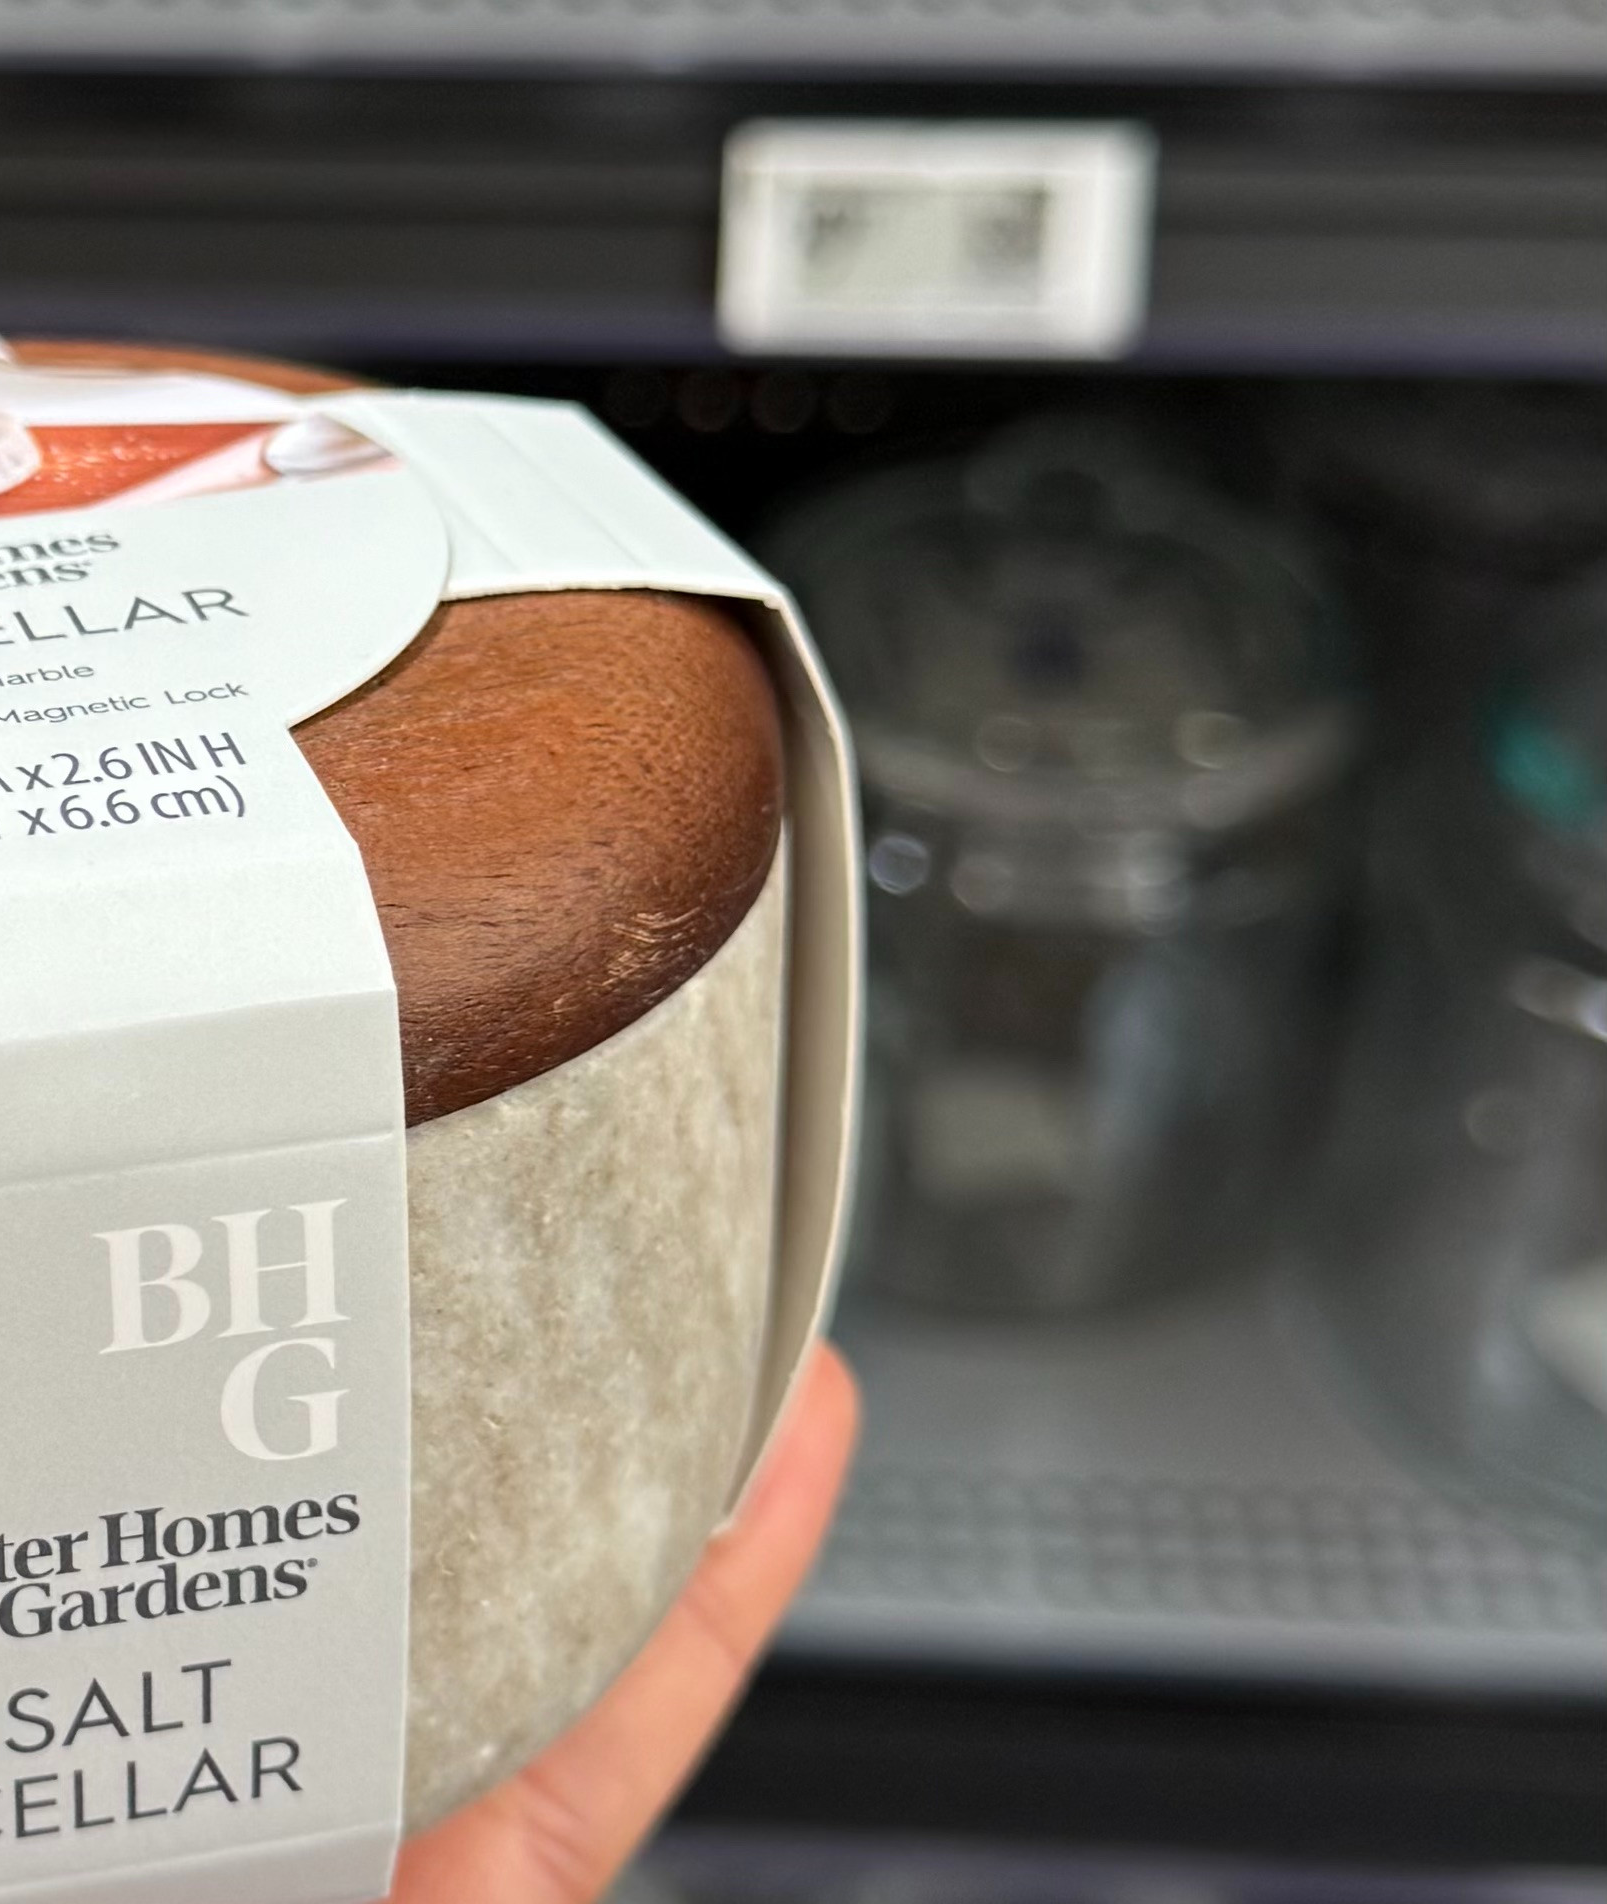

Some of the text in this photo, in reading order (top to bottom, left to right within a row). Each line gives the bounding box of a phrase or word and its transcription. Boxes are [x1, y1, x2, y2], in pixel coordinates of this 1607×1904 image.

[163, 682, 248, 705] Lock
[135, 737, 197, 776] IN
[199, 732, 247, 768] H
[59, 788, 141, 830] 6.6
[150, 774, 246, 820] cm)
[93, 1197, 351, 1355] BH
[220, 1337, 349, 1461] G
[99, 1494, 360, 1569] Homes
[5, 1659, 232, 1754] SALT
